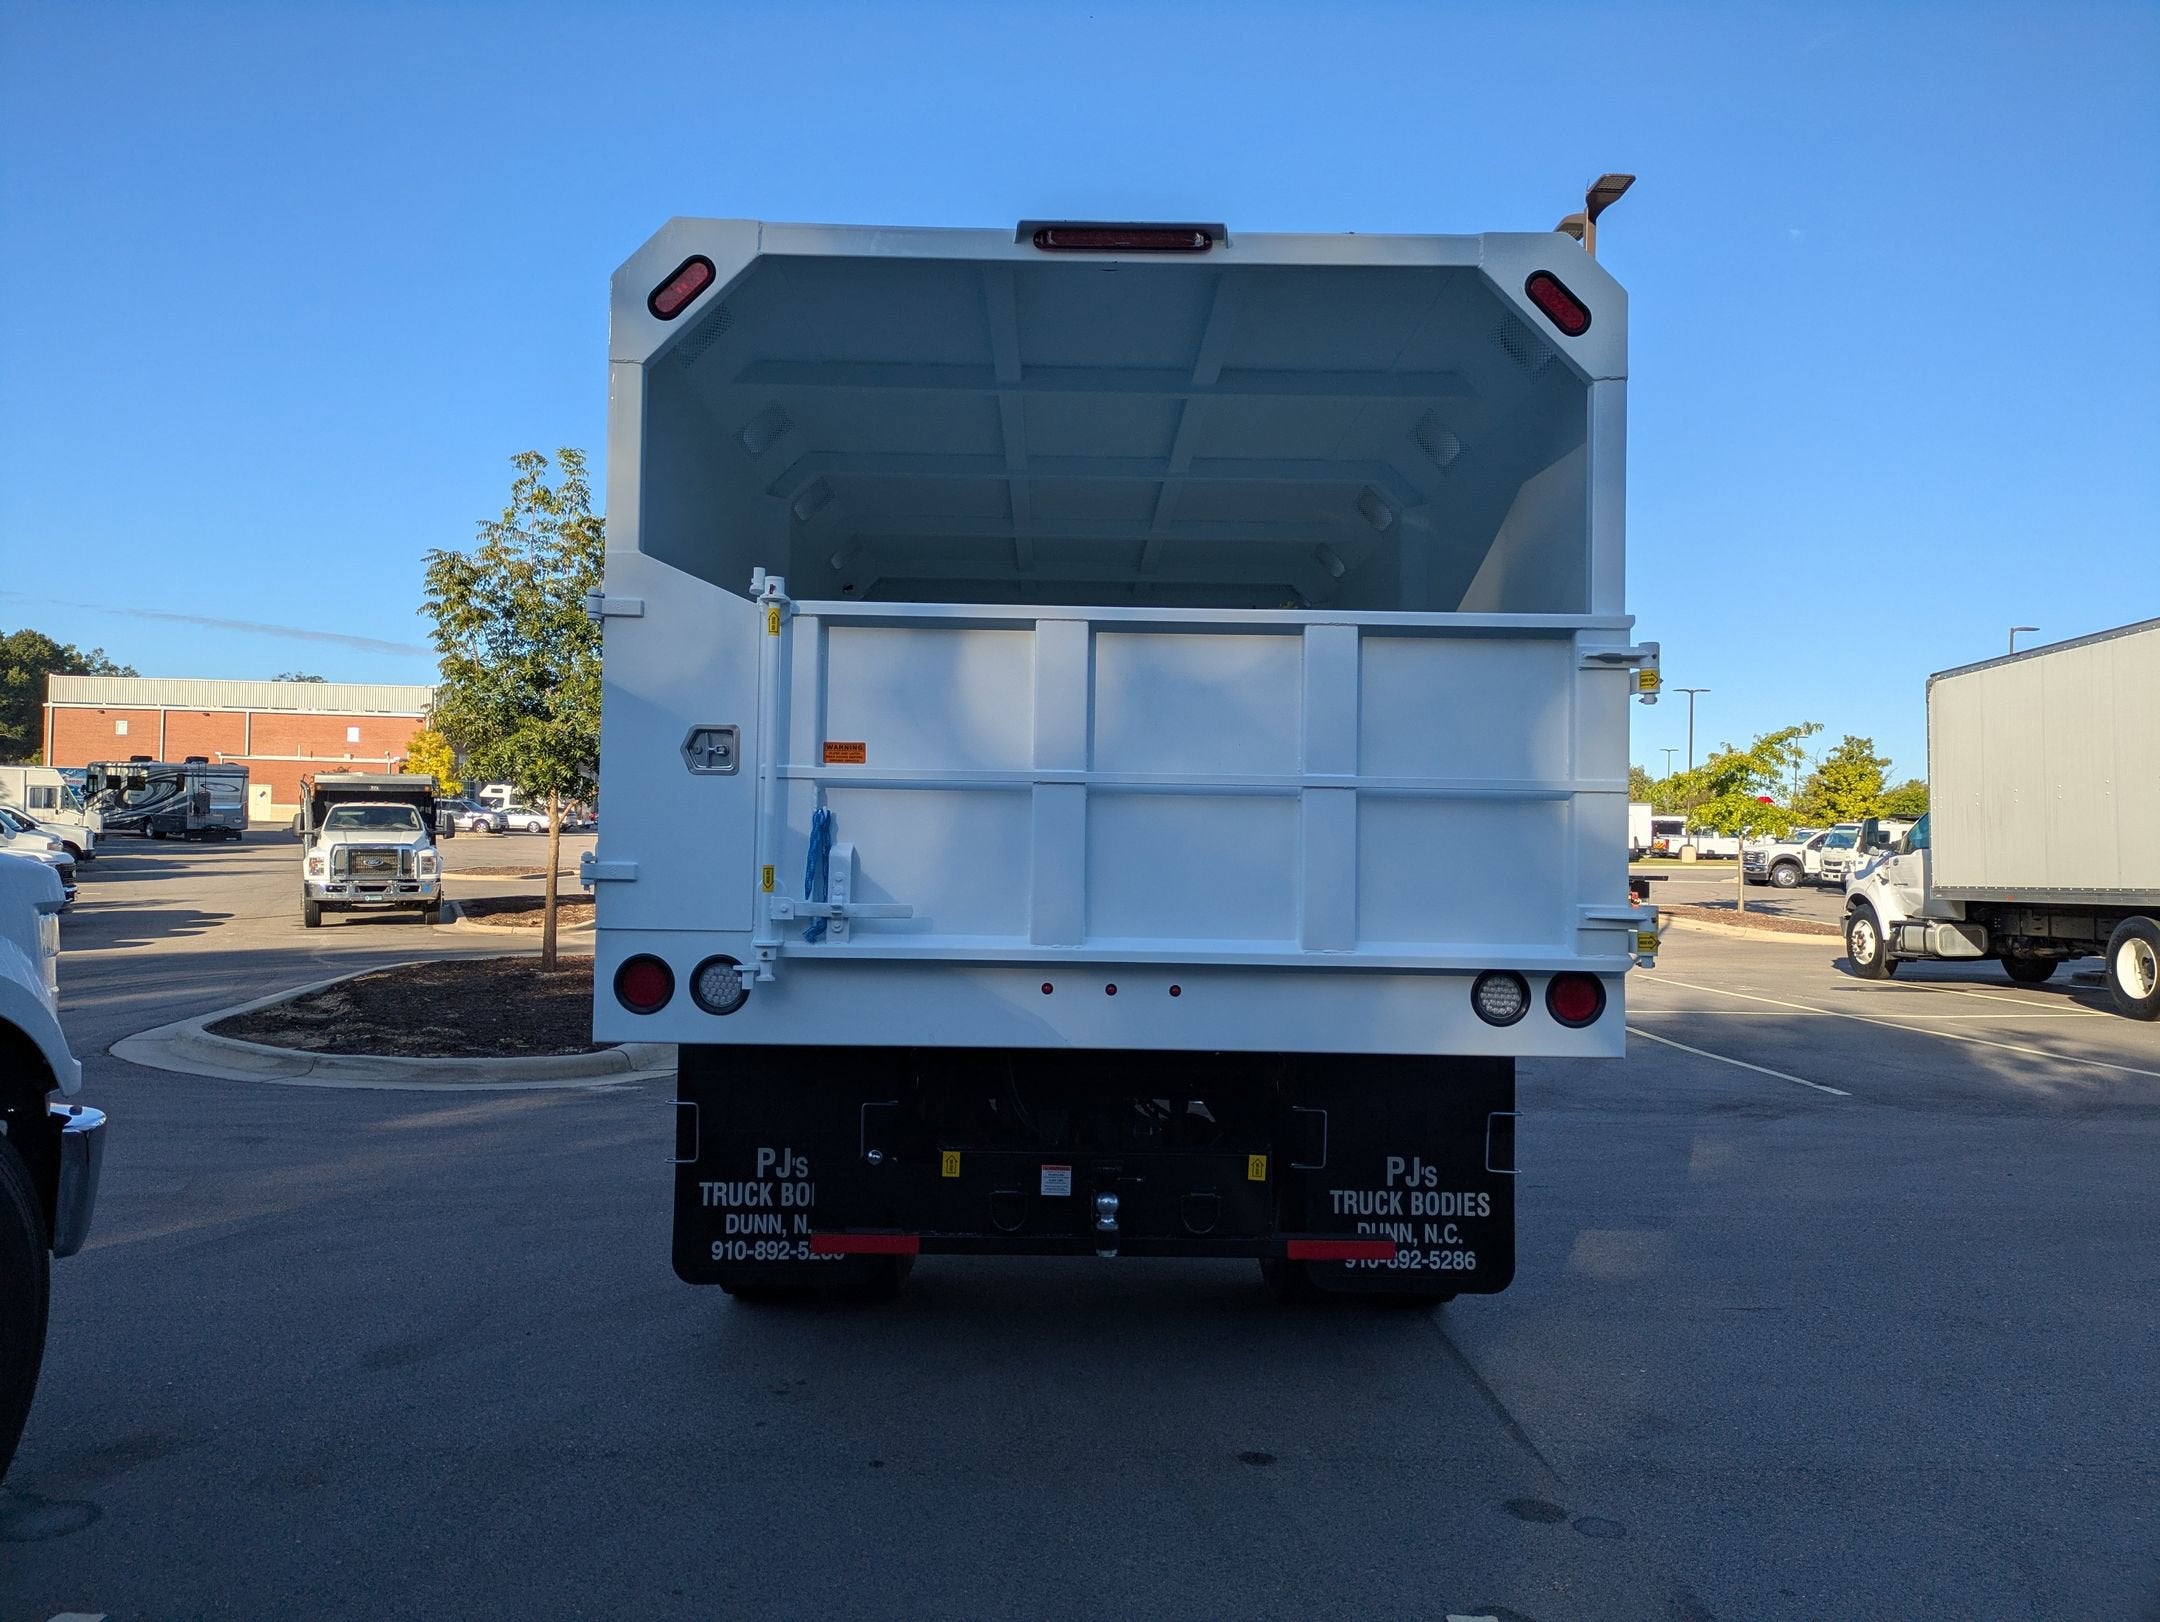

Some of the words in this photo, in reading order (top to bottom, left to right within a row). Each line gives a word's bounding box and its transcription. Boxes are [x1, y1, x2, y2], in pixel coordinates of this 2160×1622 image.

[756, 1147, 809, 1178] PJ's
[1386, 1156, 1438, 1188] PJ's
[698, 1181, 774, 1207] TRUCK
[780, 1181, 815, 1207] BO
[1329, 1189, 1404, 1216] TRUCK
[1410, 1191, 1491, 1217] BODIES
[725, 1213, 788, 1238] DUNN,
[1424, 1223, 1464, 1245] N.C.
